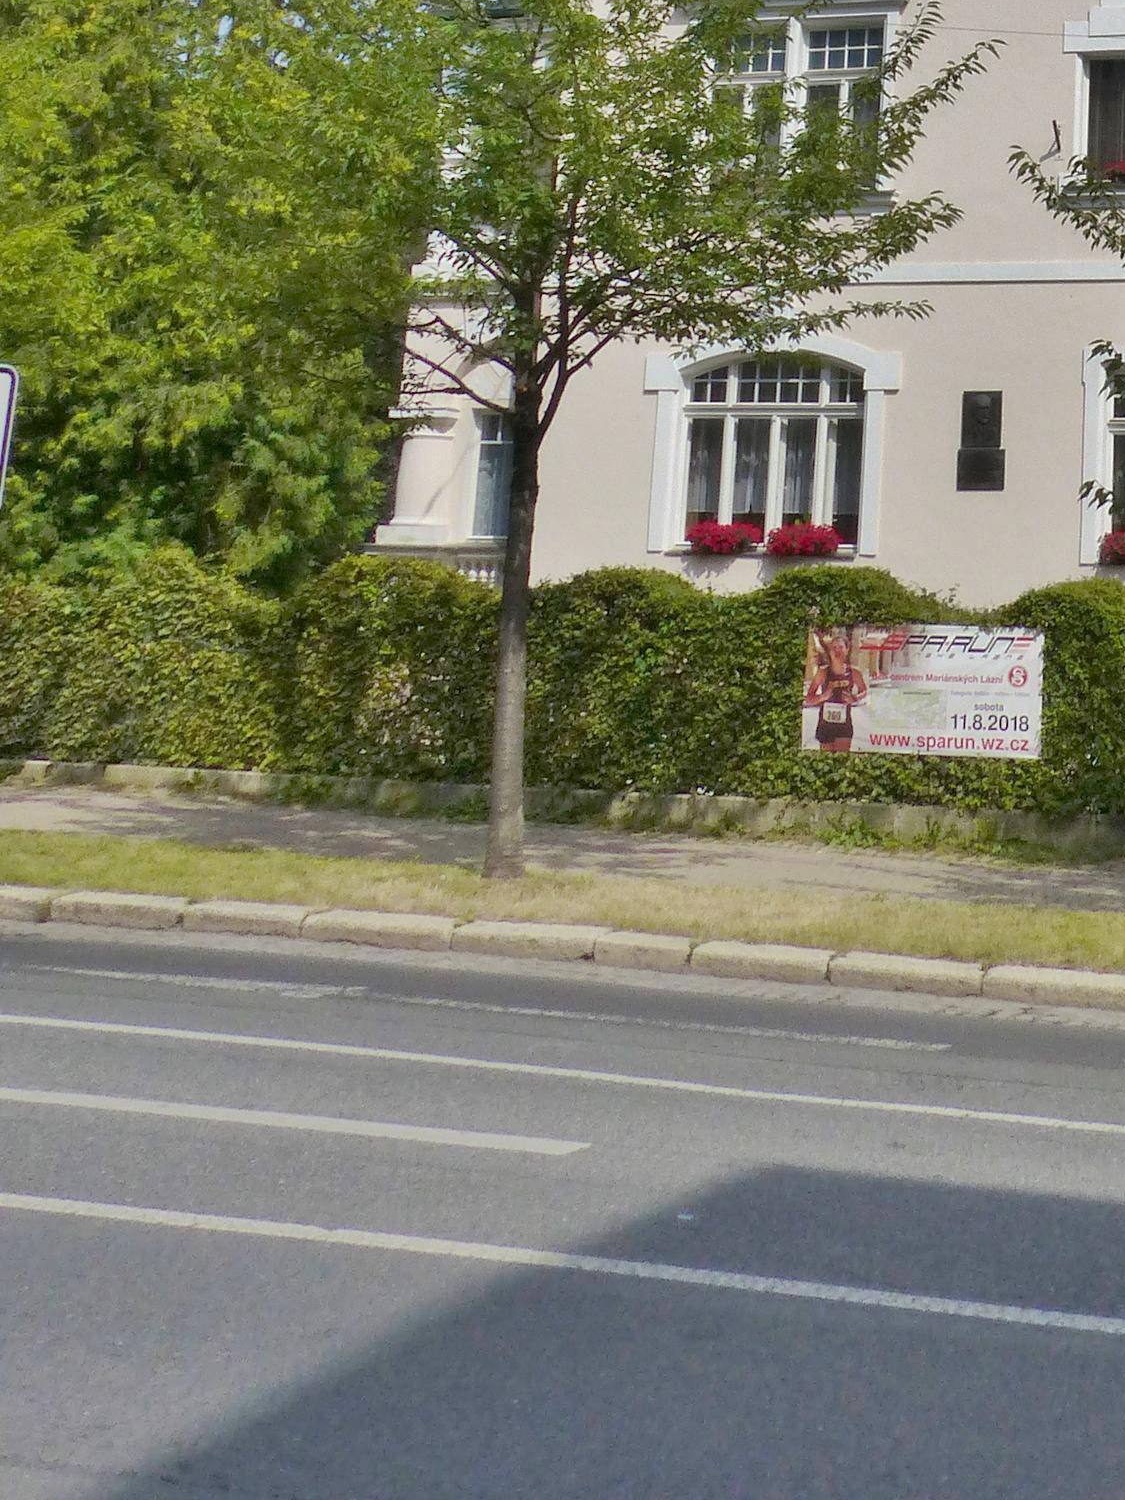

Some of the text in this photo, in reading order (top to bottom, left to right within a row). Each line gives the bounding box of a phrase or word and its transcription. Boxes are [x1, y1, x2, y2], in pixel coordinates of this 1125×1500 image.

[925, 673, 979, 685] Mariánských
[980, 674, 1004, 684] Lázní
[973, 702, 1005, 712] sobota
[950, 714, 1029, 732] 11.8.2018
[869, 733, 1030, 752] www.sparun.wz.cz
